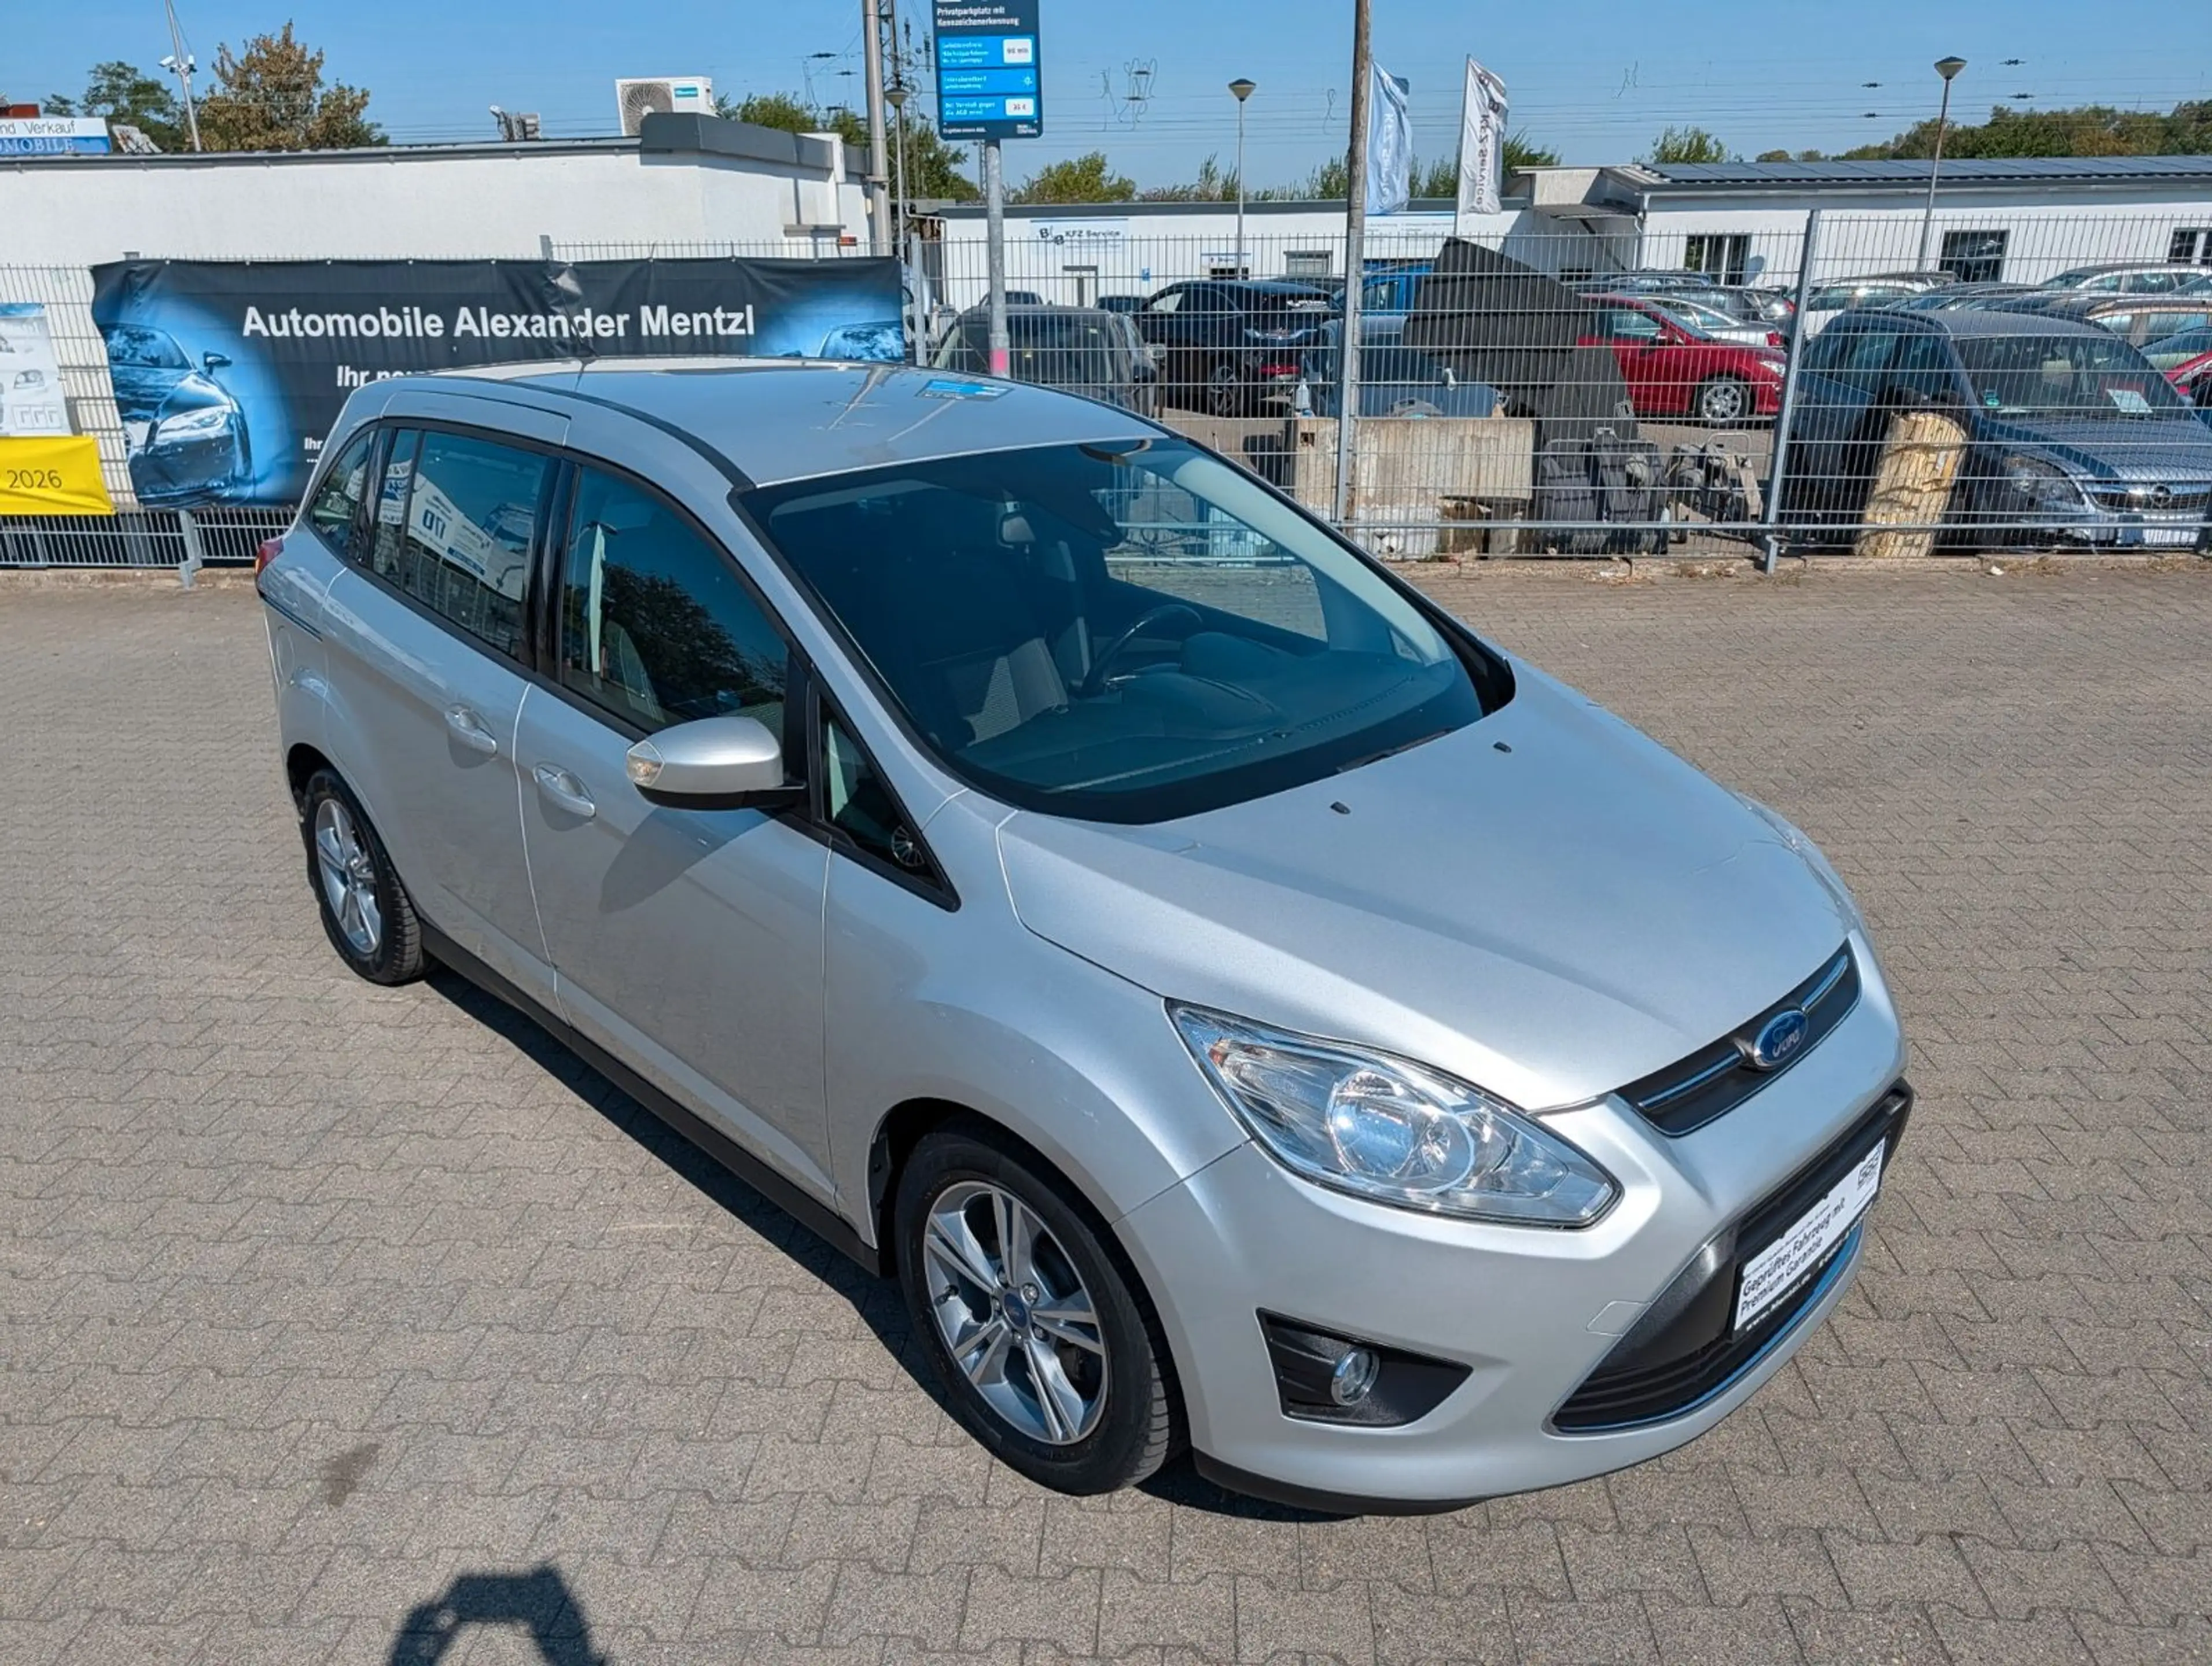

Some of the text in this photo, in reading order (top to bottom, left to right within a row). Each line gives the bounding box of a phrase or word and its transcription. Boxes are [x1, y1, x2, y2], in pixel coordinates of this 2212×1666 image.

[937, 6, 1005, 16] Privatparkplatz mit
[937, 17, 1020, 27] Kennzeichenerkennung
[24, 120, 76, 134] Verkauf
[0, 138, 73, 152] MOBILE
[243, 304, 754, 339] Automobile Alexander Mentzl
[337, 365, 370, 387] Ihr
[304, 437, 323, 450] Ihr
[7, 469, 62, 489] 2026
[1771, 1017, 1800, 1058] Ford
[1742, 1248, 1791, 1297] Geprüftes
[1792, 1212, 1832, 1255] Fahrzeug
[1832, 1197, 1846, 1219] mit
[1740, 1273, 1785, 1316] Premium
[1786, 1236, 1823, 1277] Garantie
